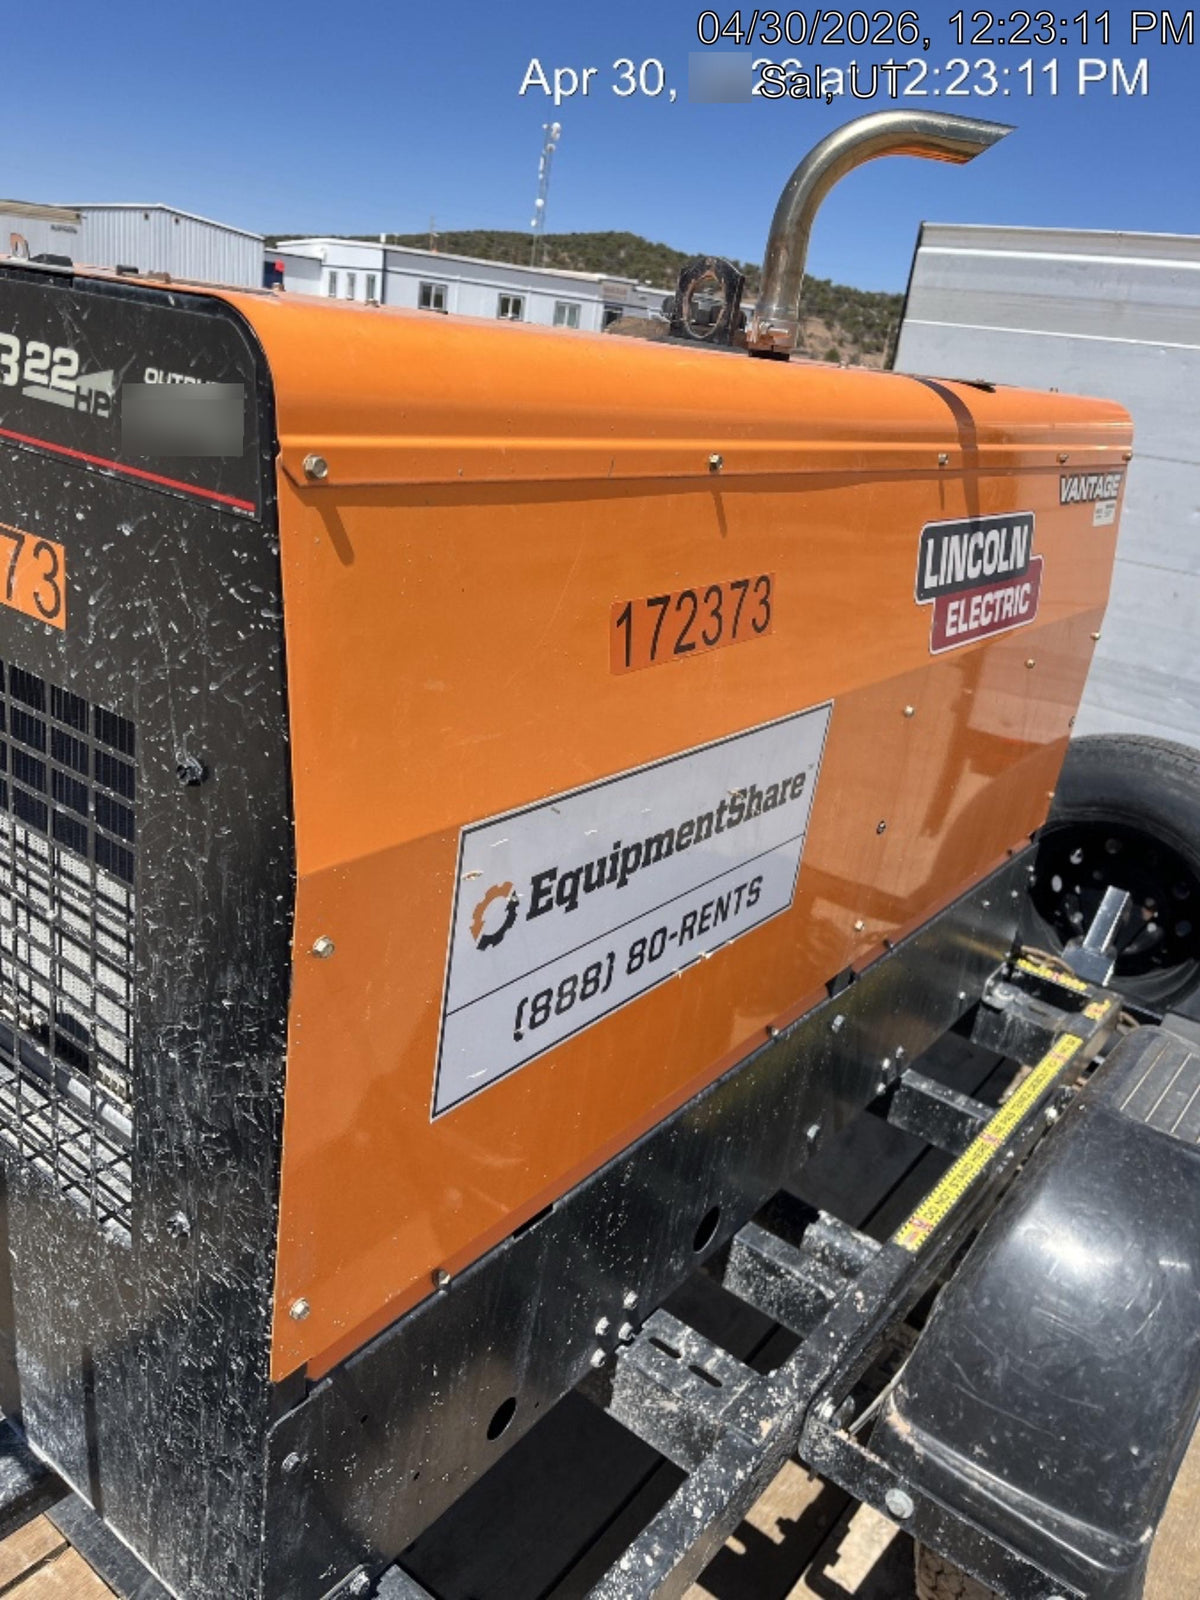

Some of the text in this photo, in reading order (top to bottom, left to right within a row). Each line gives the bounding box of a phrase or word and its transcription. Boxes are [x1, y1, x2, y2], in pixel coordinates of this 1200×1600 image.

[1060, 473, 1121, 503] VANTAGE
[923, 524, 1029, 590] LINCOLN
[615, 575, 772, 668] 172373
[945, 582, 1032, 638] ELECTRIC
[525, 770, 807, 922] EquipmentShare
[513, 875, 765, 1043] (888) 80-RENTS
